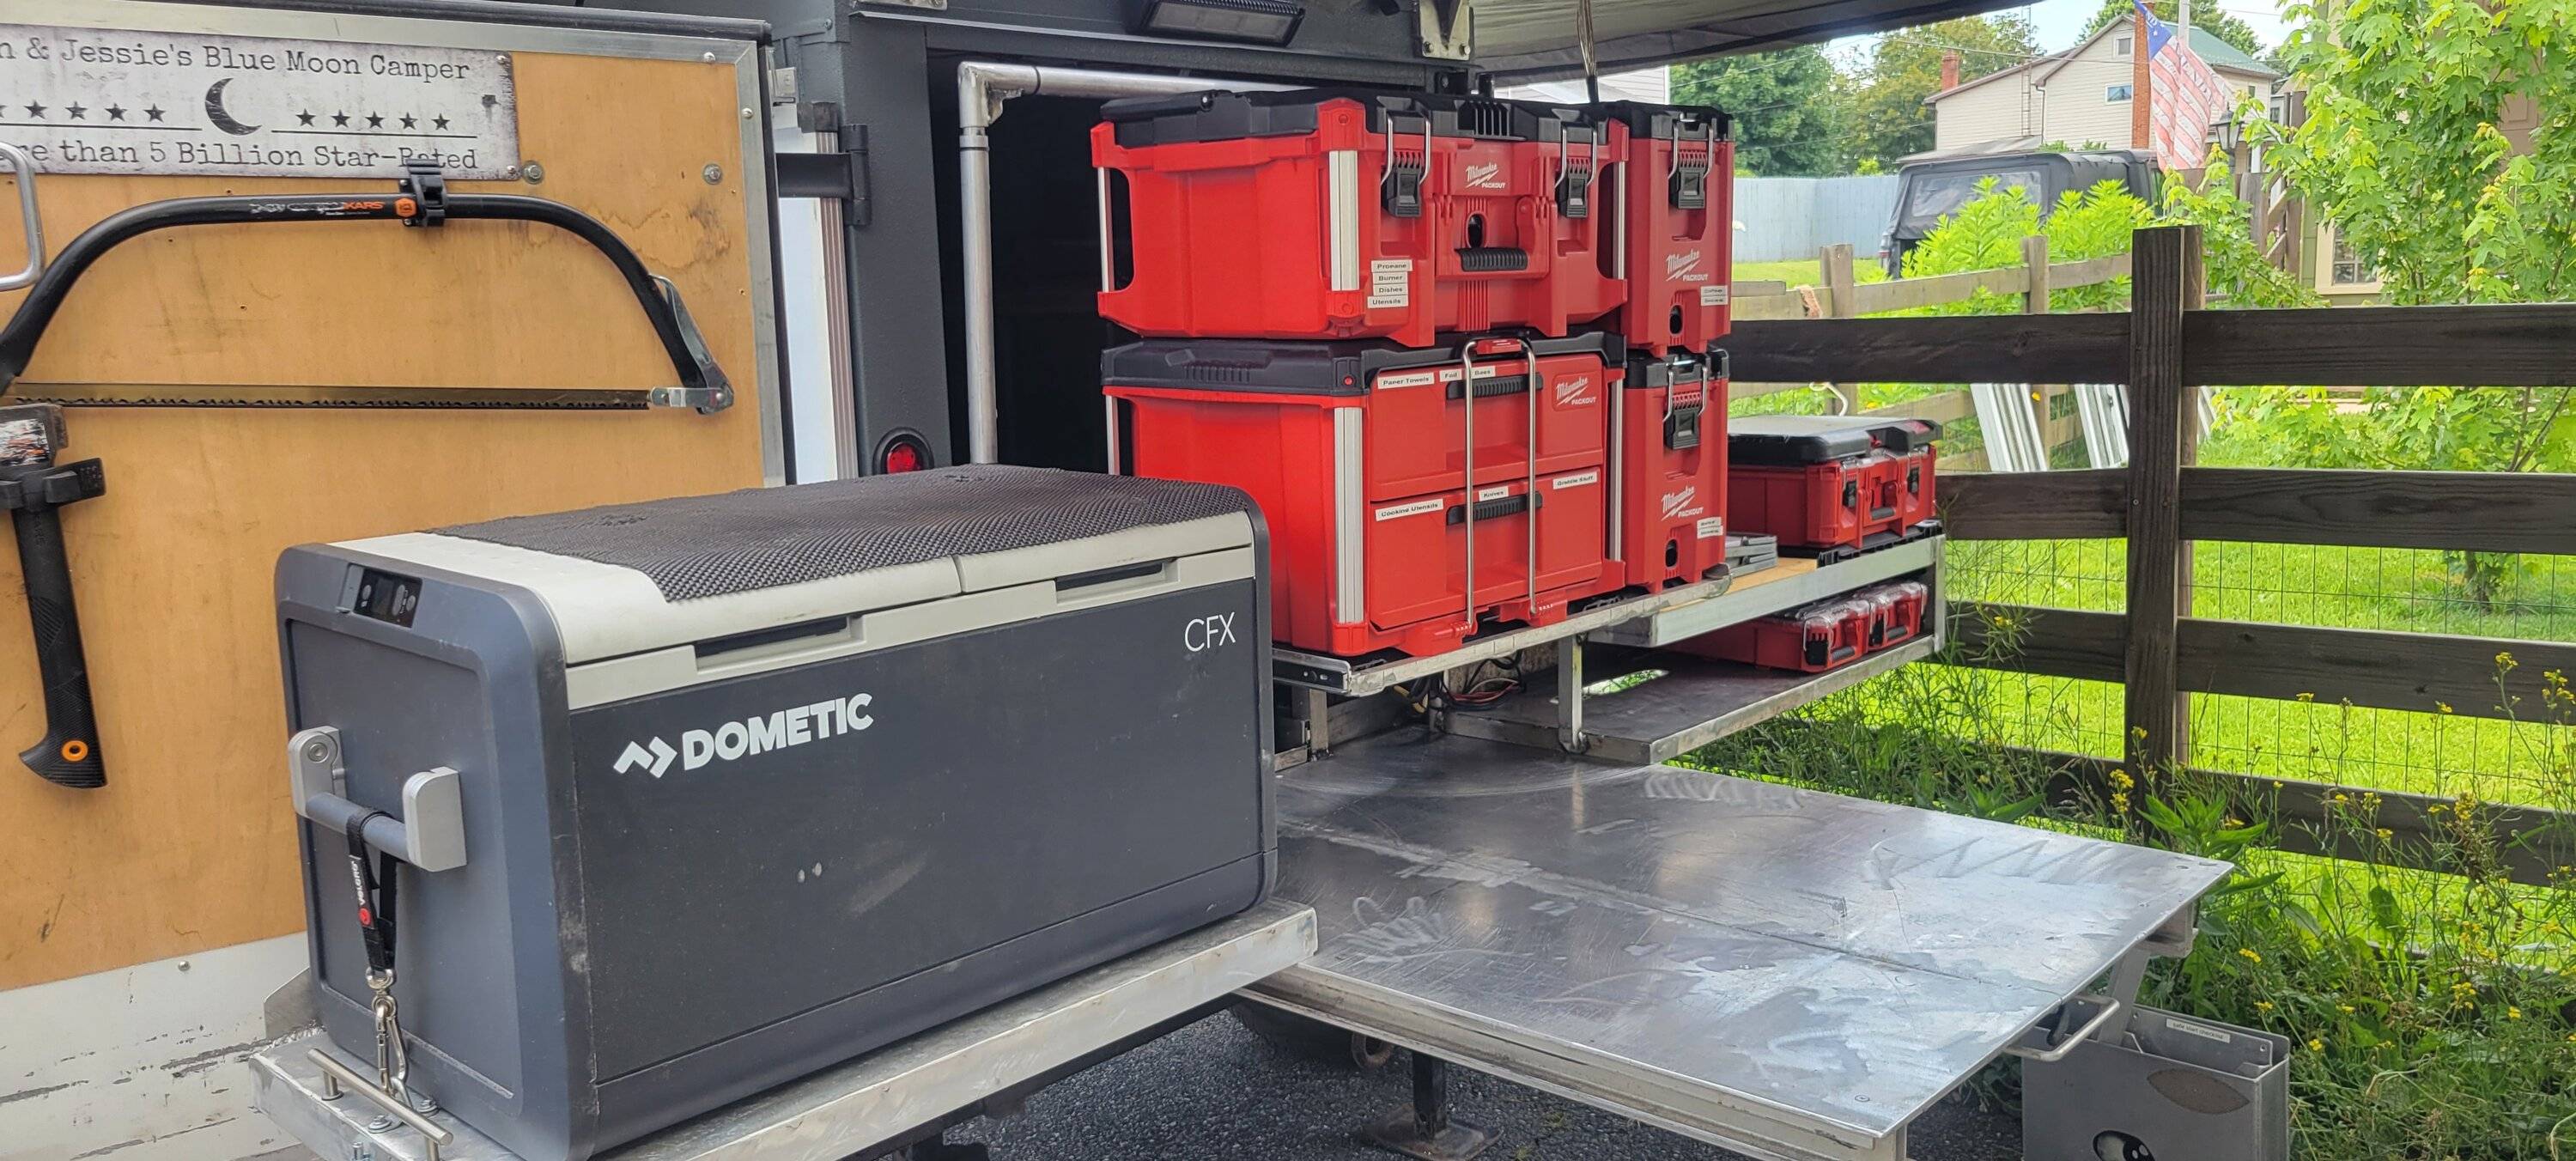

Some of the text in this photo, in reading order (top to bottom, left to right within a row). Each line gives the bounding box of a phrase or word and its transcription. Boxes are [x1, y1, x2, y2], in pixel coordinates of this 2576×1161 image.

[27, 37, 49, 60] &
[61, 39, 193, 66] Jessie's
[203, 46, 276, 70] Blue
[285, 50, 361, 75] Moon
[370, 54, 471, 83] Camper
[58, 140, 139, 163] than
[150, 141, 166, 162] 5
[176, 142, 305, 167] Billion
[1185, 611, 1236, 652] CFX
[682, 693, 874, 771] DOMETIC
